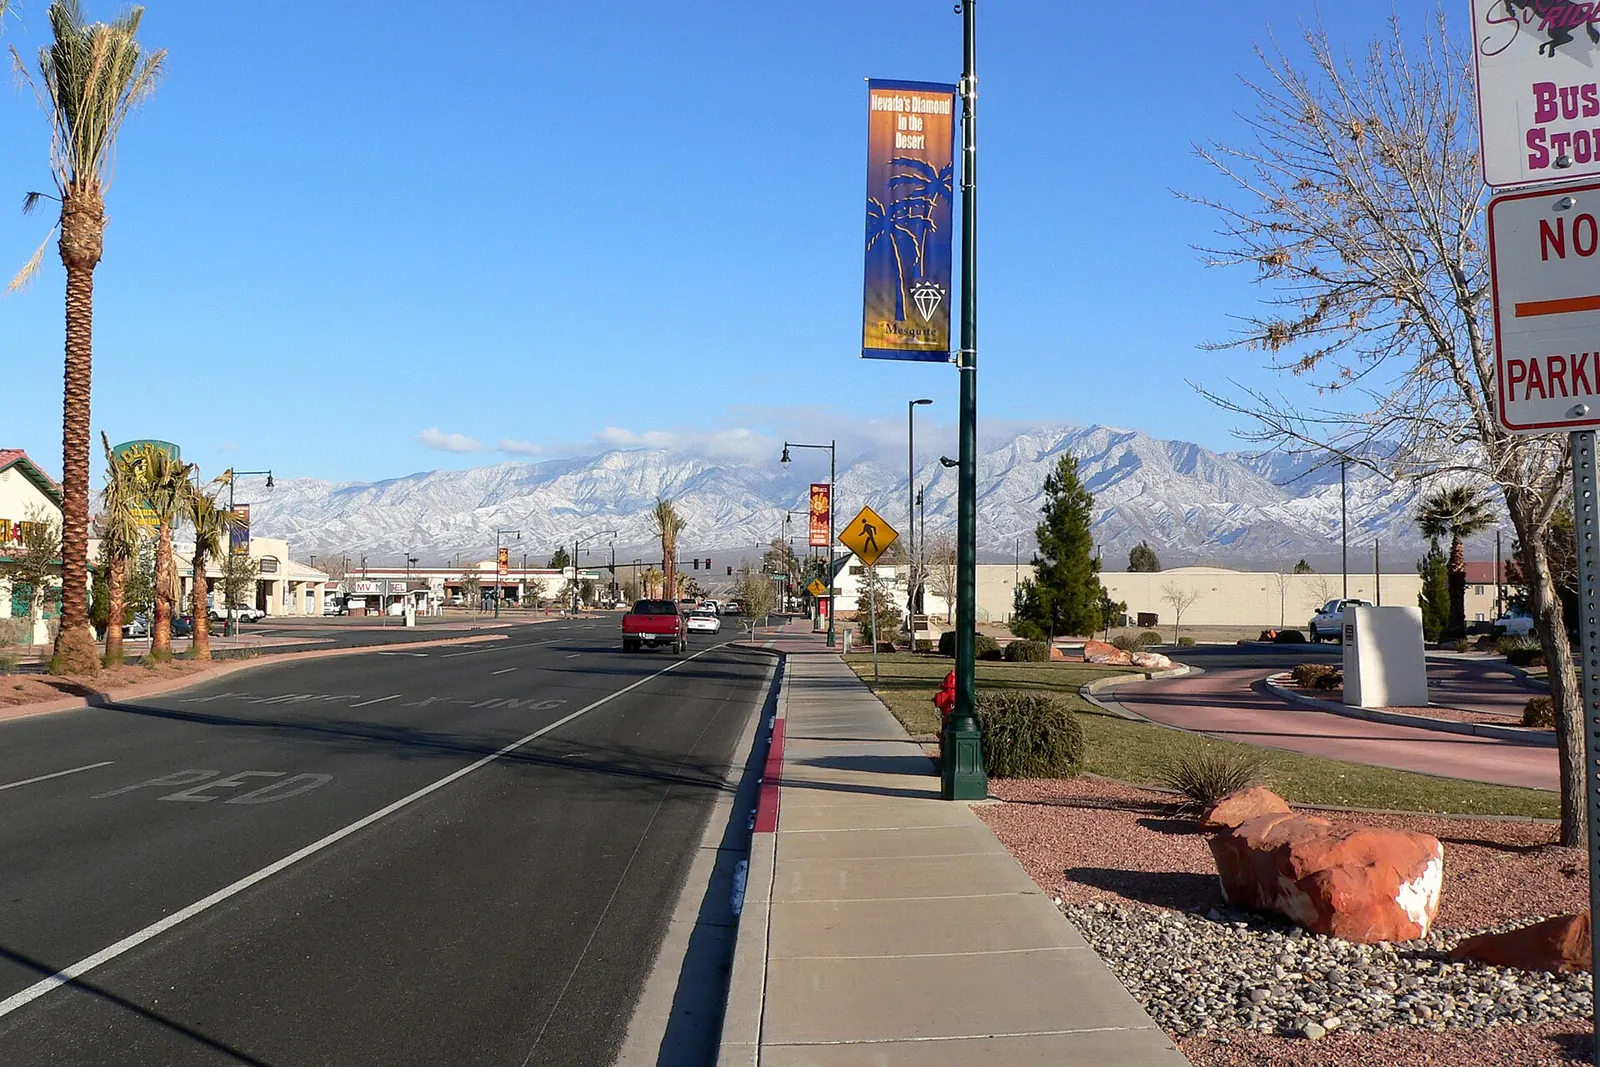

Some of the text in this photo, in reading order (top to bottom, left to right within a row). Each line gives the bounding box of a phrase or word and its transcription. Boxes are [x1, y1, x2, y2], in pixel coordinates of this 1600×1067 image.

[871, 94, 950, 115] Nevada's Diamond
[1532, 82, 1600, 124] BUS
[908, 114, 923, 132] the
[895, 132, 925, 149] Desert
[1539, 213, 1598, 261] NO
[885, 323, 937, 338] Mesquite
[91, 768, 334, 805] PED
